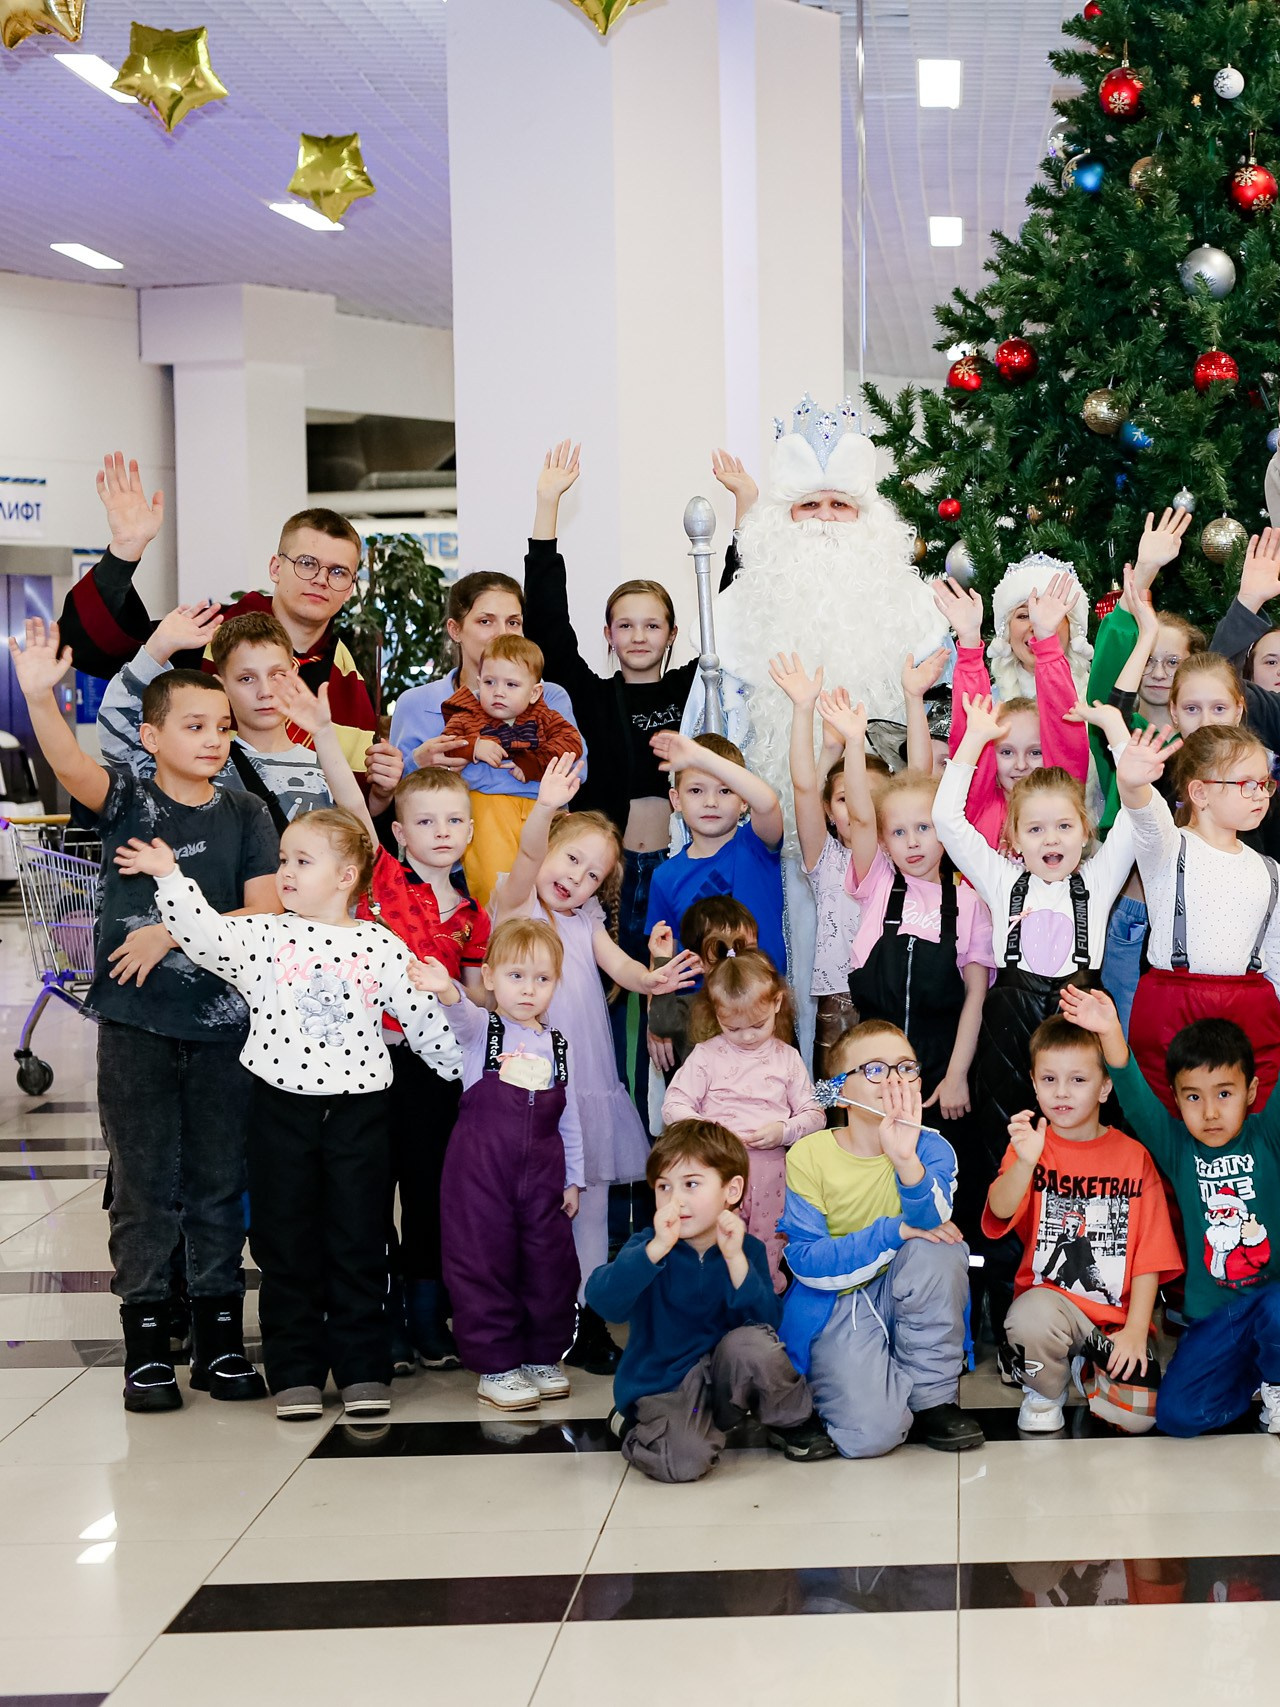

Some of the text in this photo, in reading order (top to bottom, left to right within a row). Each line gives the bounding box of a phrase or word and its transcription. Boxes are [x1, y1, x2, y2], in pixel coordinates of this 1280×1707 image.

[173, 840, 207, 860] DREA
[1008, 895, 1023, 949] FUTINO
[559, 1062, 567, 1081] arte
[1194, 1154, 1254, 1178] ARTY
[1033, 1163, 1143, 1199] BASKETBALL
